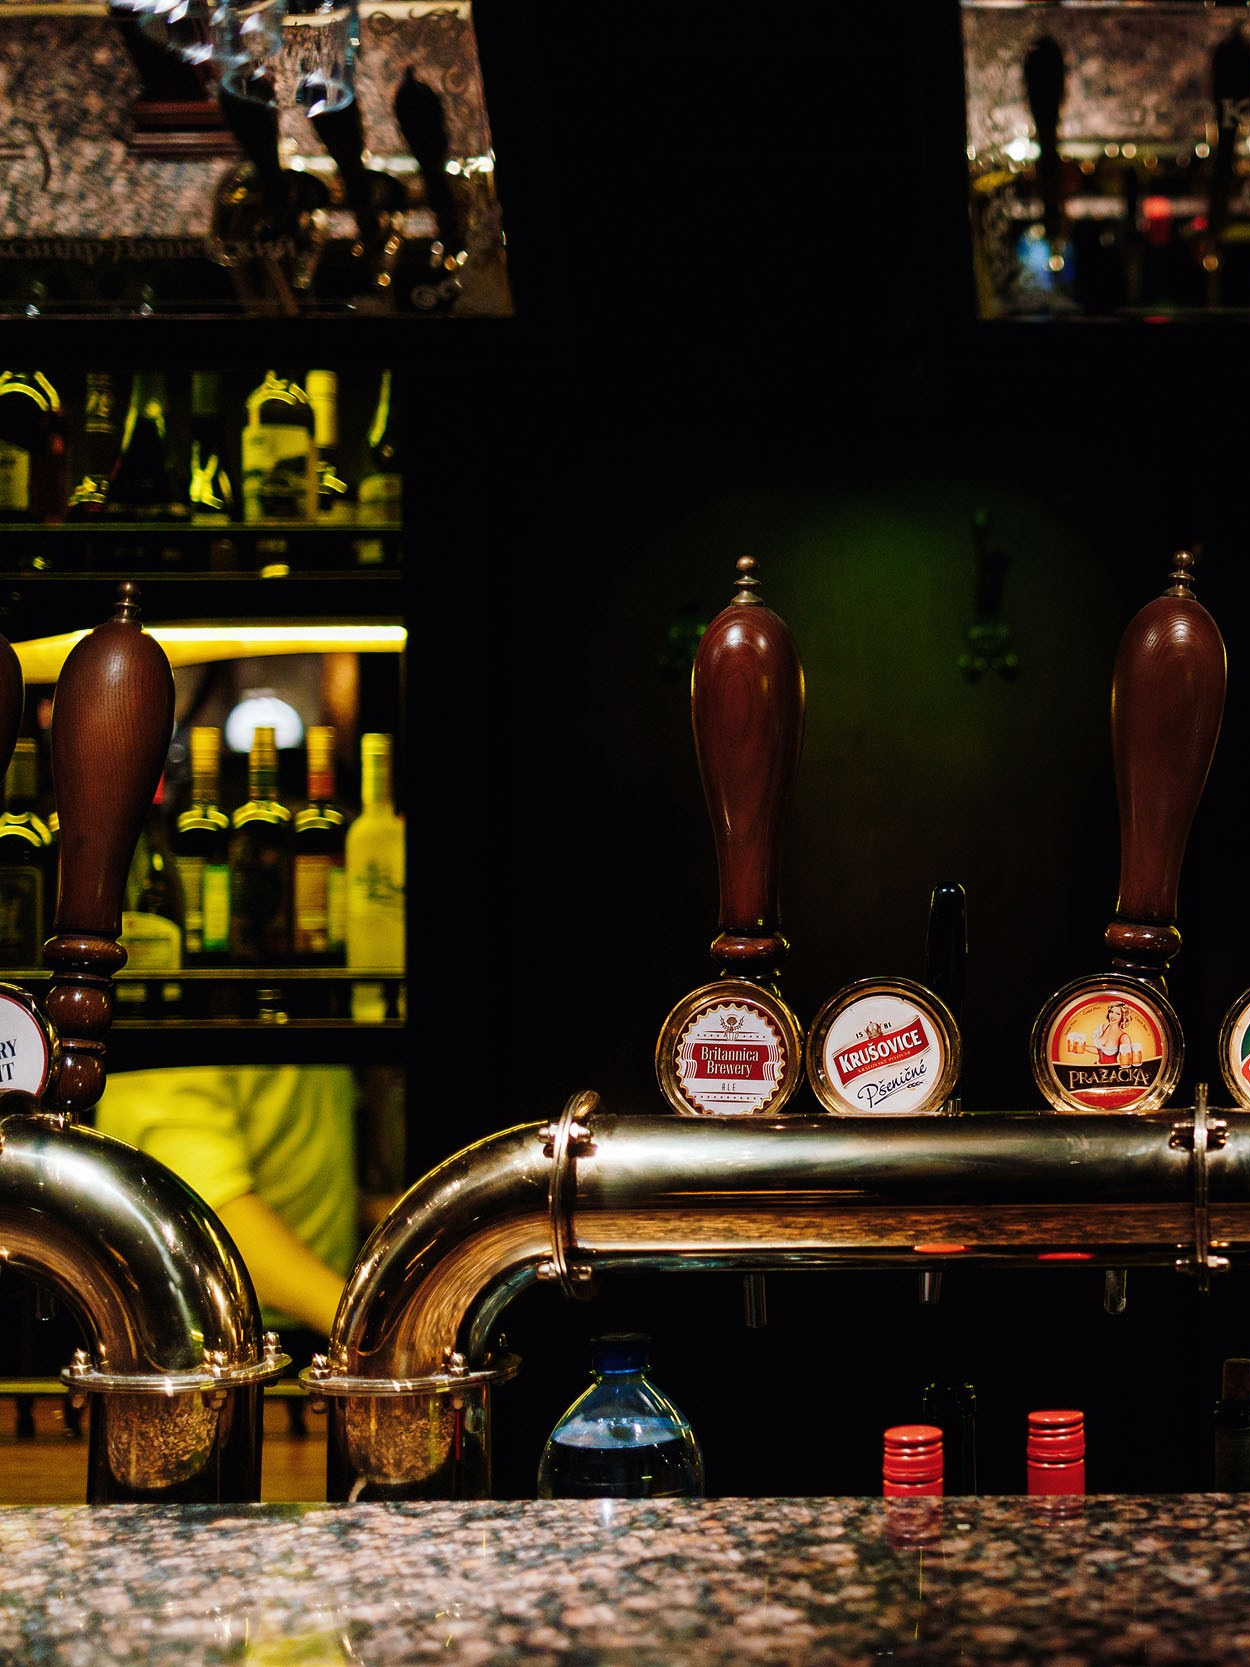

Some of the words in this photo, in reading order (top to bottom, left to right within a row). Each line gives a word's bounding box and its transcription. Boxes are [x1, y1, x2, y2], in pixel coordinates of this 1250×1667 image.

[701, 1046, 759, 1062] Britannica
[838, 1029, 922, 1073] KRUŠOVICE
[706, 1060, 753, 1078] Brewery
[721, 1083, 736, 1091] ALE
[857, 1059, 927, 1109] Pšeničné
